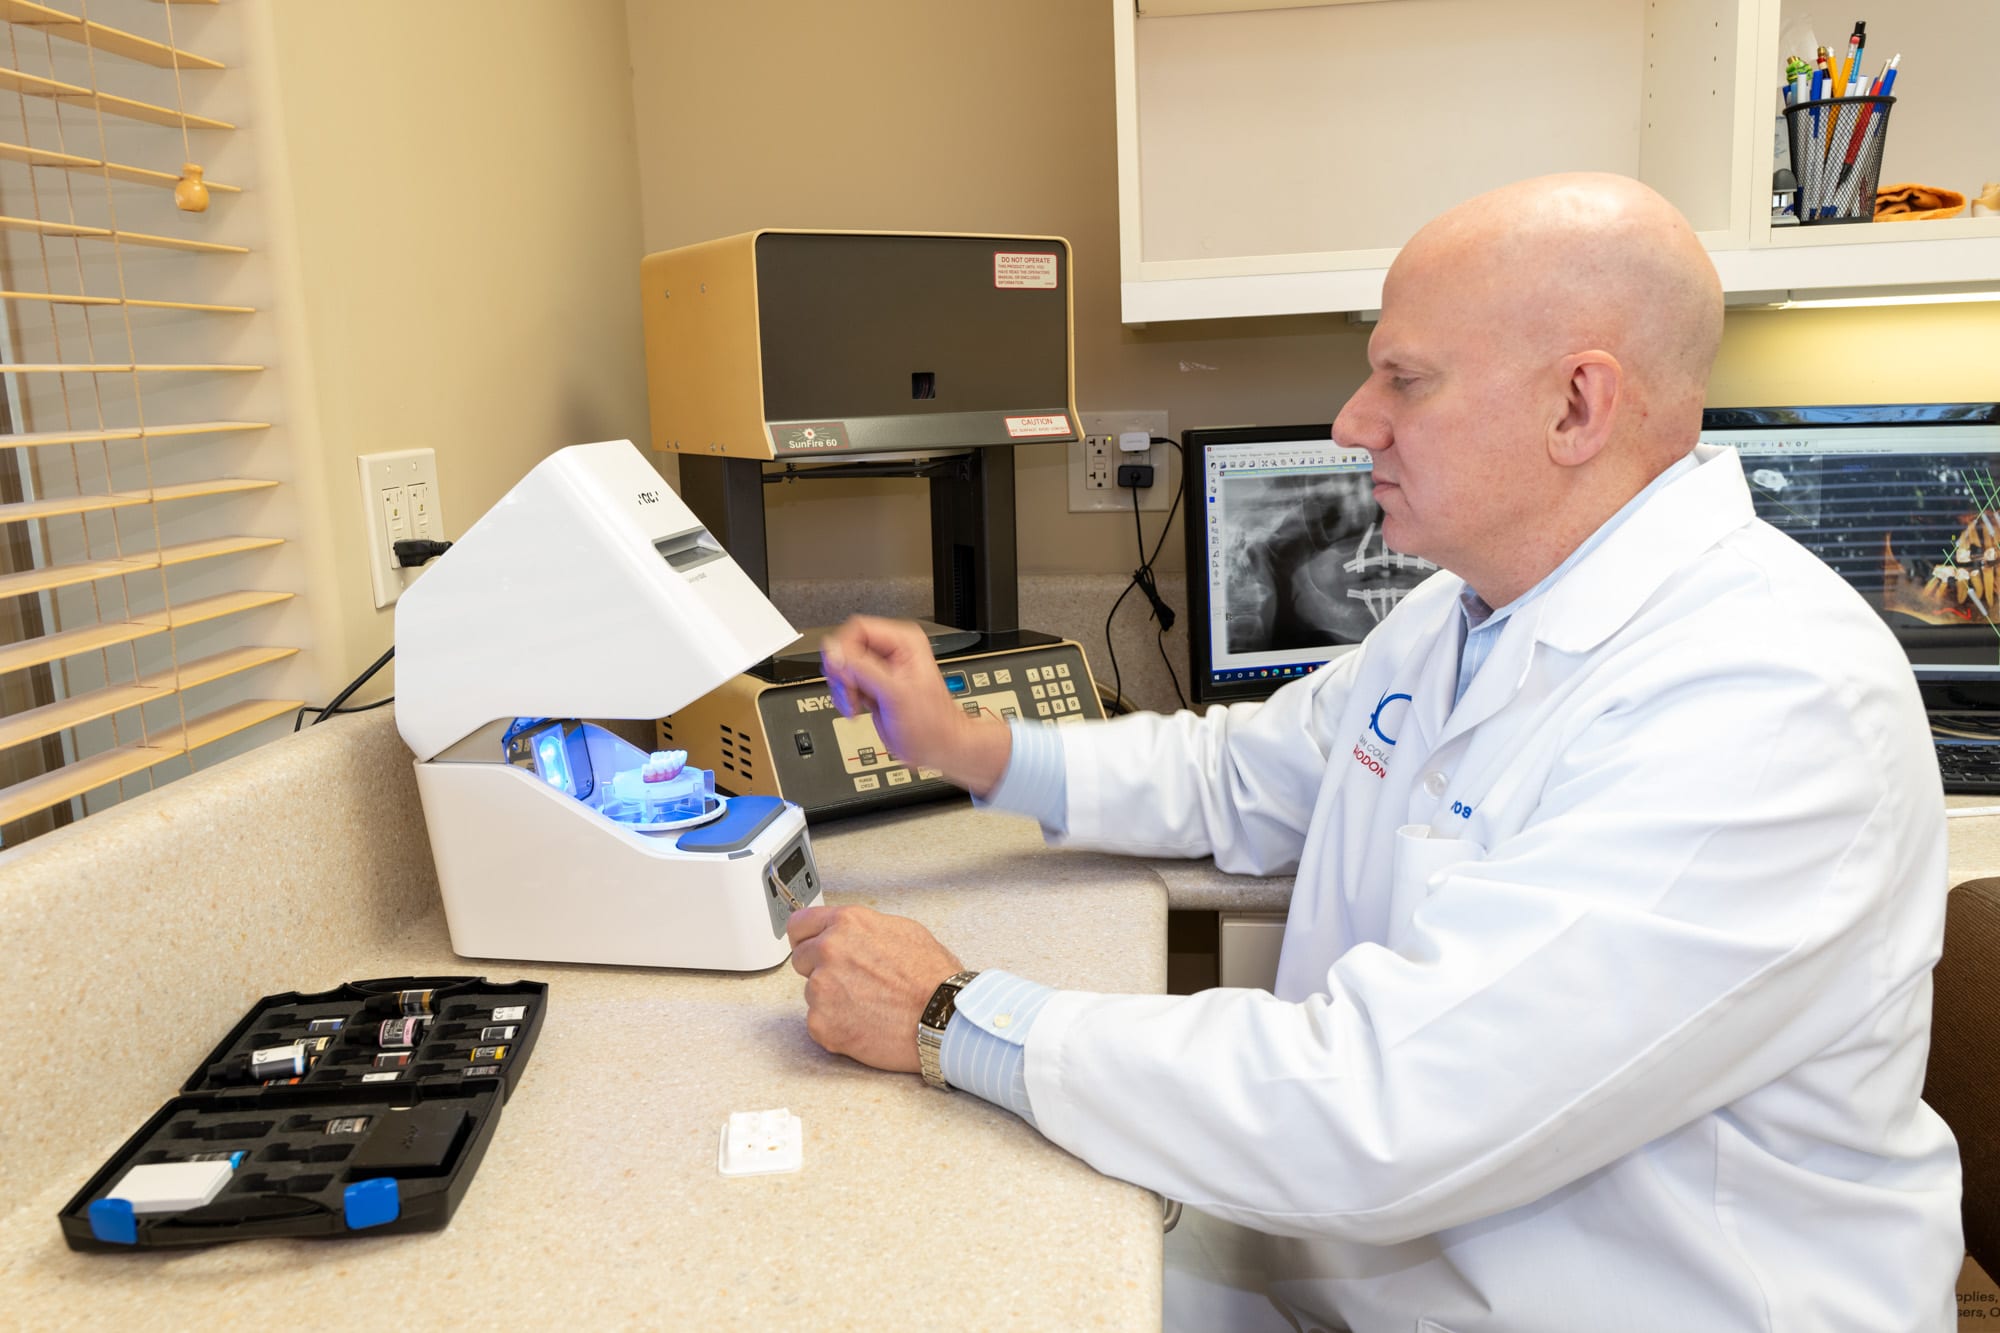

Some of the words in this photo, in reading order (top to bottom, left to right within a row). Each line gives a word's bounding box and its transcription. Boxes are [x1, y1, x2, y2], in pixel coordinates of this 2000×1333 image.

[789, 439, 824, 449] SunFire
[826, 439, 837, 447] 60
[1045, 669, 1051, 677] 2
[1060, 667, 1066, 675] 3
[1035, 688, 1041, 696] 4
[796, 696, 825, 713] NEY
[1040, 705, 1046, 713] 7
[1070, 700, 1076, 708] 9
